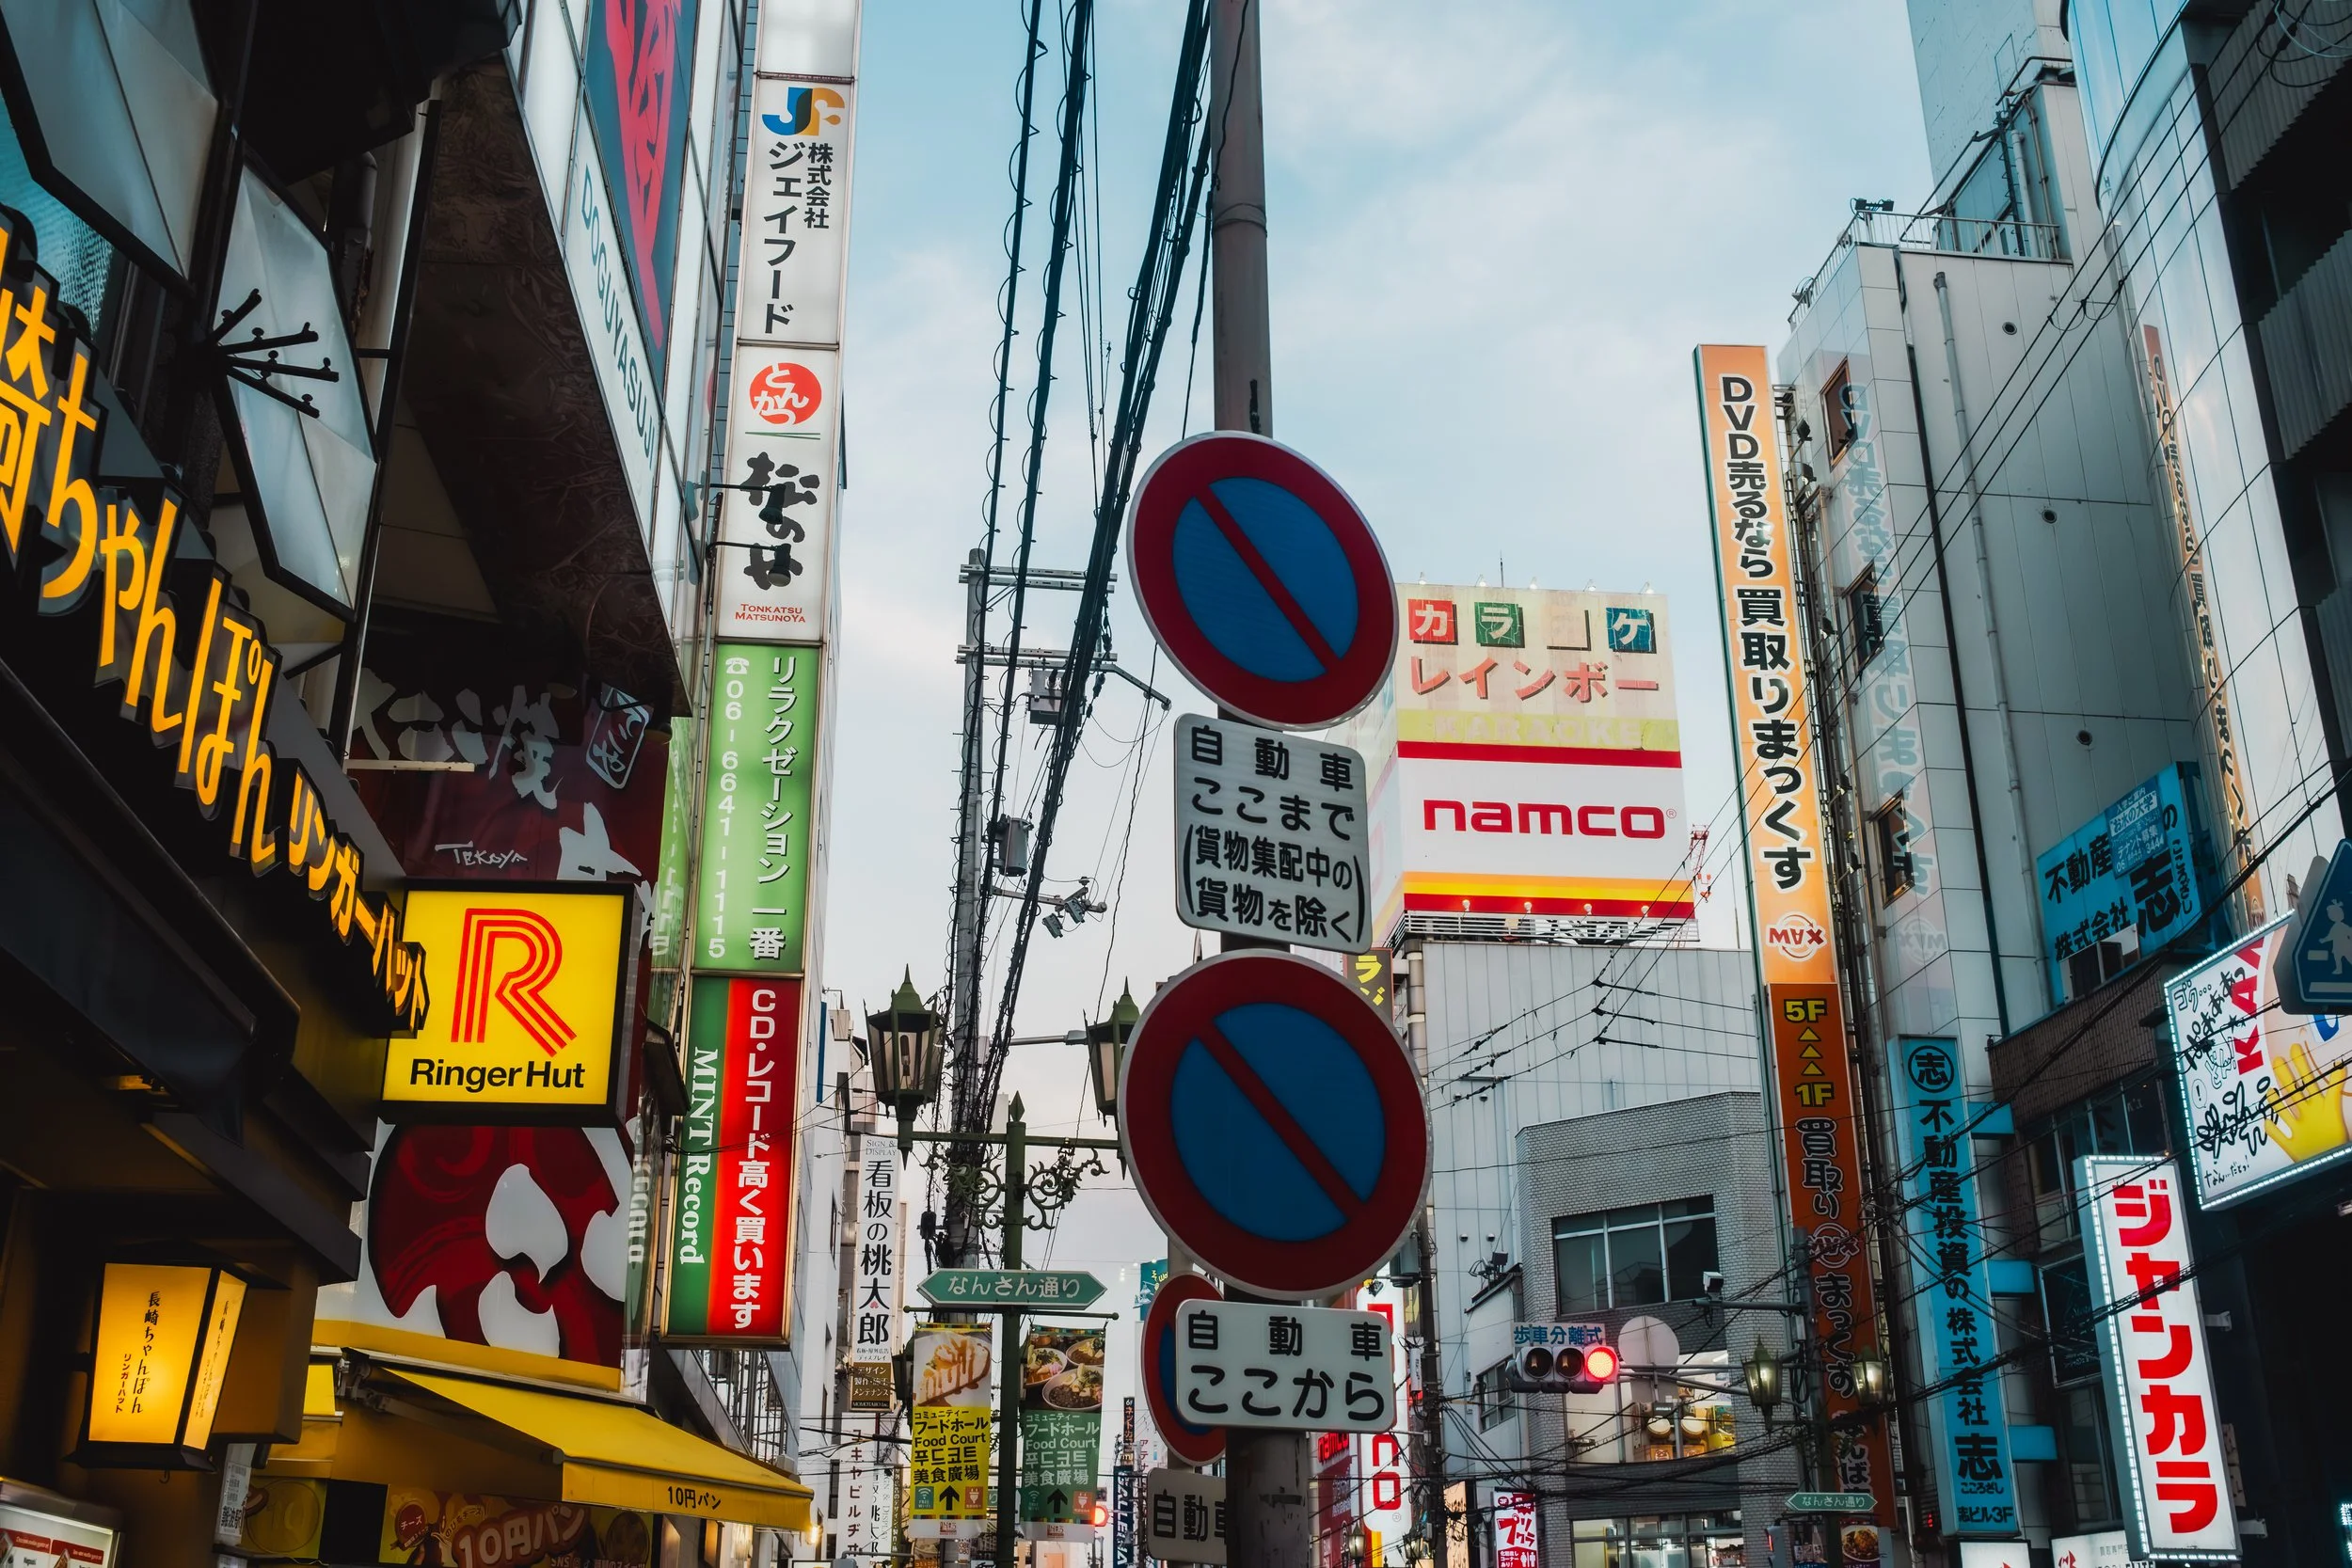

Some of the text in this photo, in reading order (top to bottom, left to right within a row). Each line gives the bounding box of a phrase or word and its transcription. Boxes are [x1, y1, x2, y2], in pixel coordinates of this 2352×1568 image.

[803, 143, 834, 230] 株式会社
[581, 164, 655, 470] DOGUYASUJI
[755, 362, 809, 425] とんかつ
[1722, 376, 1812, 890] DVD売るなら 買取りまっくす
[1411, 656, 1660, 704] レインボー
[1436, 716, 1642, 745] KARAOKE
[1191, 725, 1354, 791] 自動車
[749, 656, 798, 960] リラクゼーション 一番
[1191, 776, 1355, 842] ここまで
[1423, 800, 1665, 839] namco
[2172, 838, 2193, 915] こころざし
[287, 770, 429, 1036] リンガーハット
[2055, 855, 2183, 962] 株式会社 志
[1785, 1000, 1827, 1022] 5F
[409, 1059, 585, 1092] Ringer Hut
[1795, 1083, 1835, 1106] 1F
[679, 1046, 719, 1265] MINT Record
[734, 989, 776, 1329] CD・レコード高く買います
[857, 1160, 895, 1346] 看板の桃太郎
[947, 1276, 1081, 1298] なんさん通り
[1188, 1309, 1383, 1361] 自動車
[1513, 1324, 1604, 1347] 歩車分離式
[132, 1291, 162, 1414] 長崎ちゃんぽん
[2112, 1180, 2218, 1534] ジャンカラ
[115, 1353, 132, 1414] リンガーハット
[853, 1388, 889, 1397] メンテナンス
[1188, 1364, 1385, 1421] ここから
[914, 1409, 970, 1419] コミュニティー
[915, 1417, 989, 1435] フードホール
[1025, 1413, 1080, 1422] コミュニティー
[1025, 1421, 1100, 1437] フードホール
[914, 1433, 986, 1449] Food Court
[914, 1446, 977, 1467] 푸드코트
[1025, 1437, 1097, 1451] Food Court
[914, 1465, 980, 1485] 美食廣場
[1025, 1450, 1088, 1469] 푸드코트
[1025, 1469, 1089, 1488] 美食廣場
[1961, 1481, 2004, 1495] こころざし
[667, 1486, 722, 1511] 10円パン
[1802, 1496, 1866, 1508] なんさん通り
[1958, 1506, 2014, 1524] 志ビル3F
[400, 1514, 423, 1530] チーズ
[1496, 1513, 1535, 1546] プリクラ
